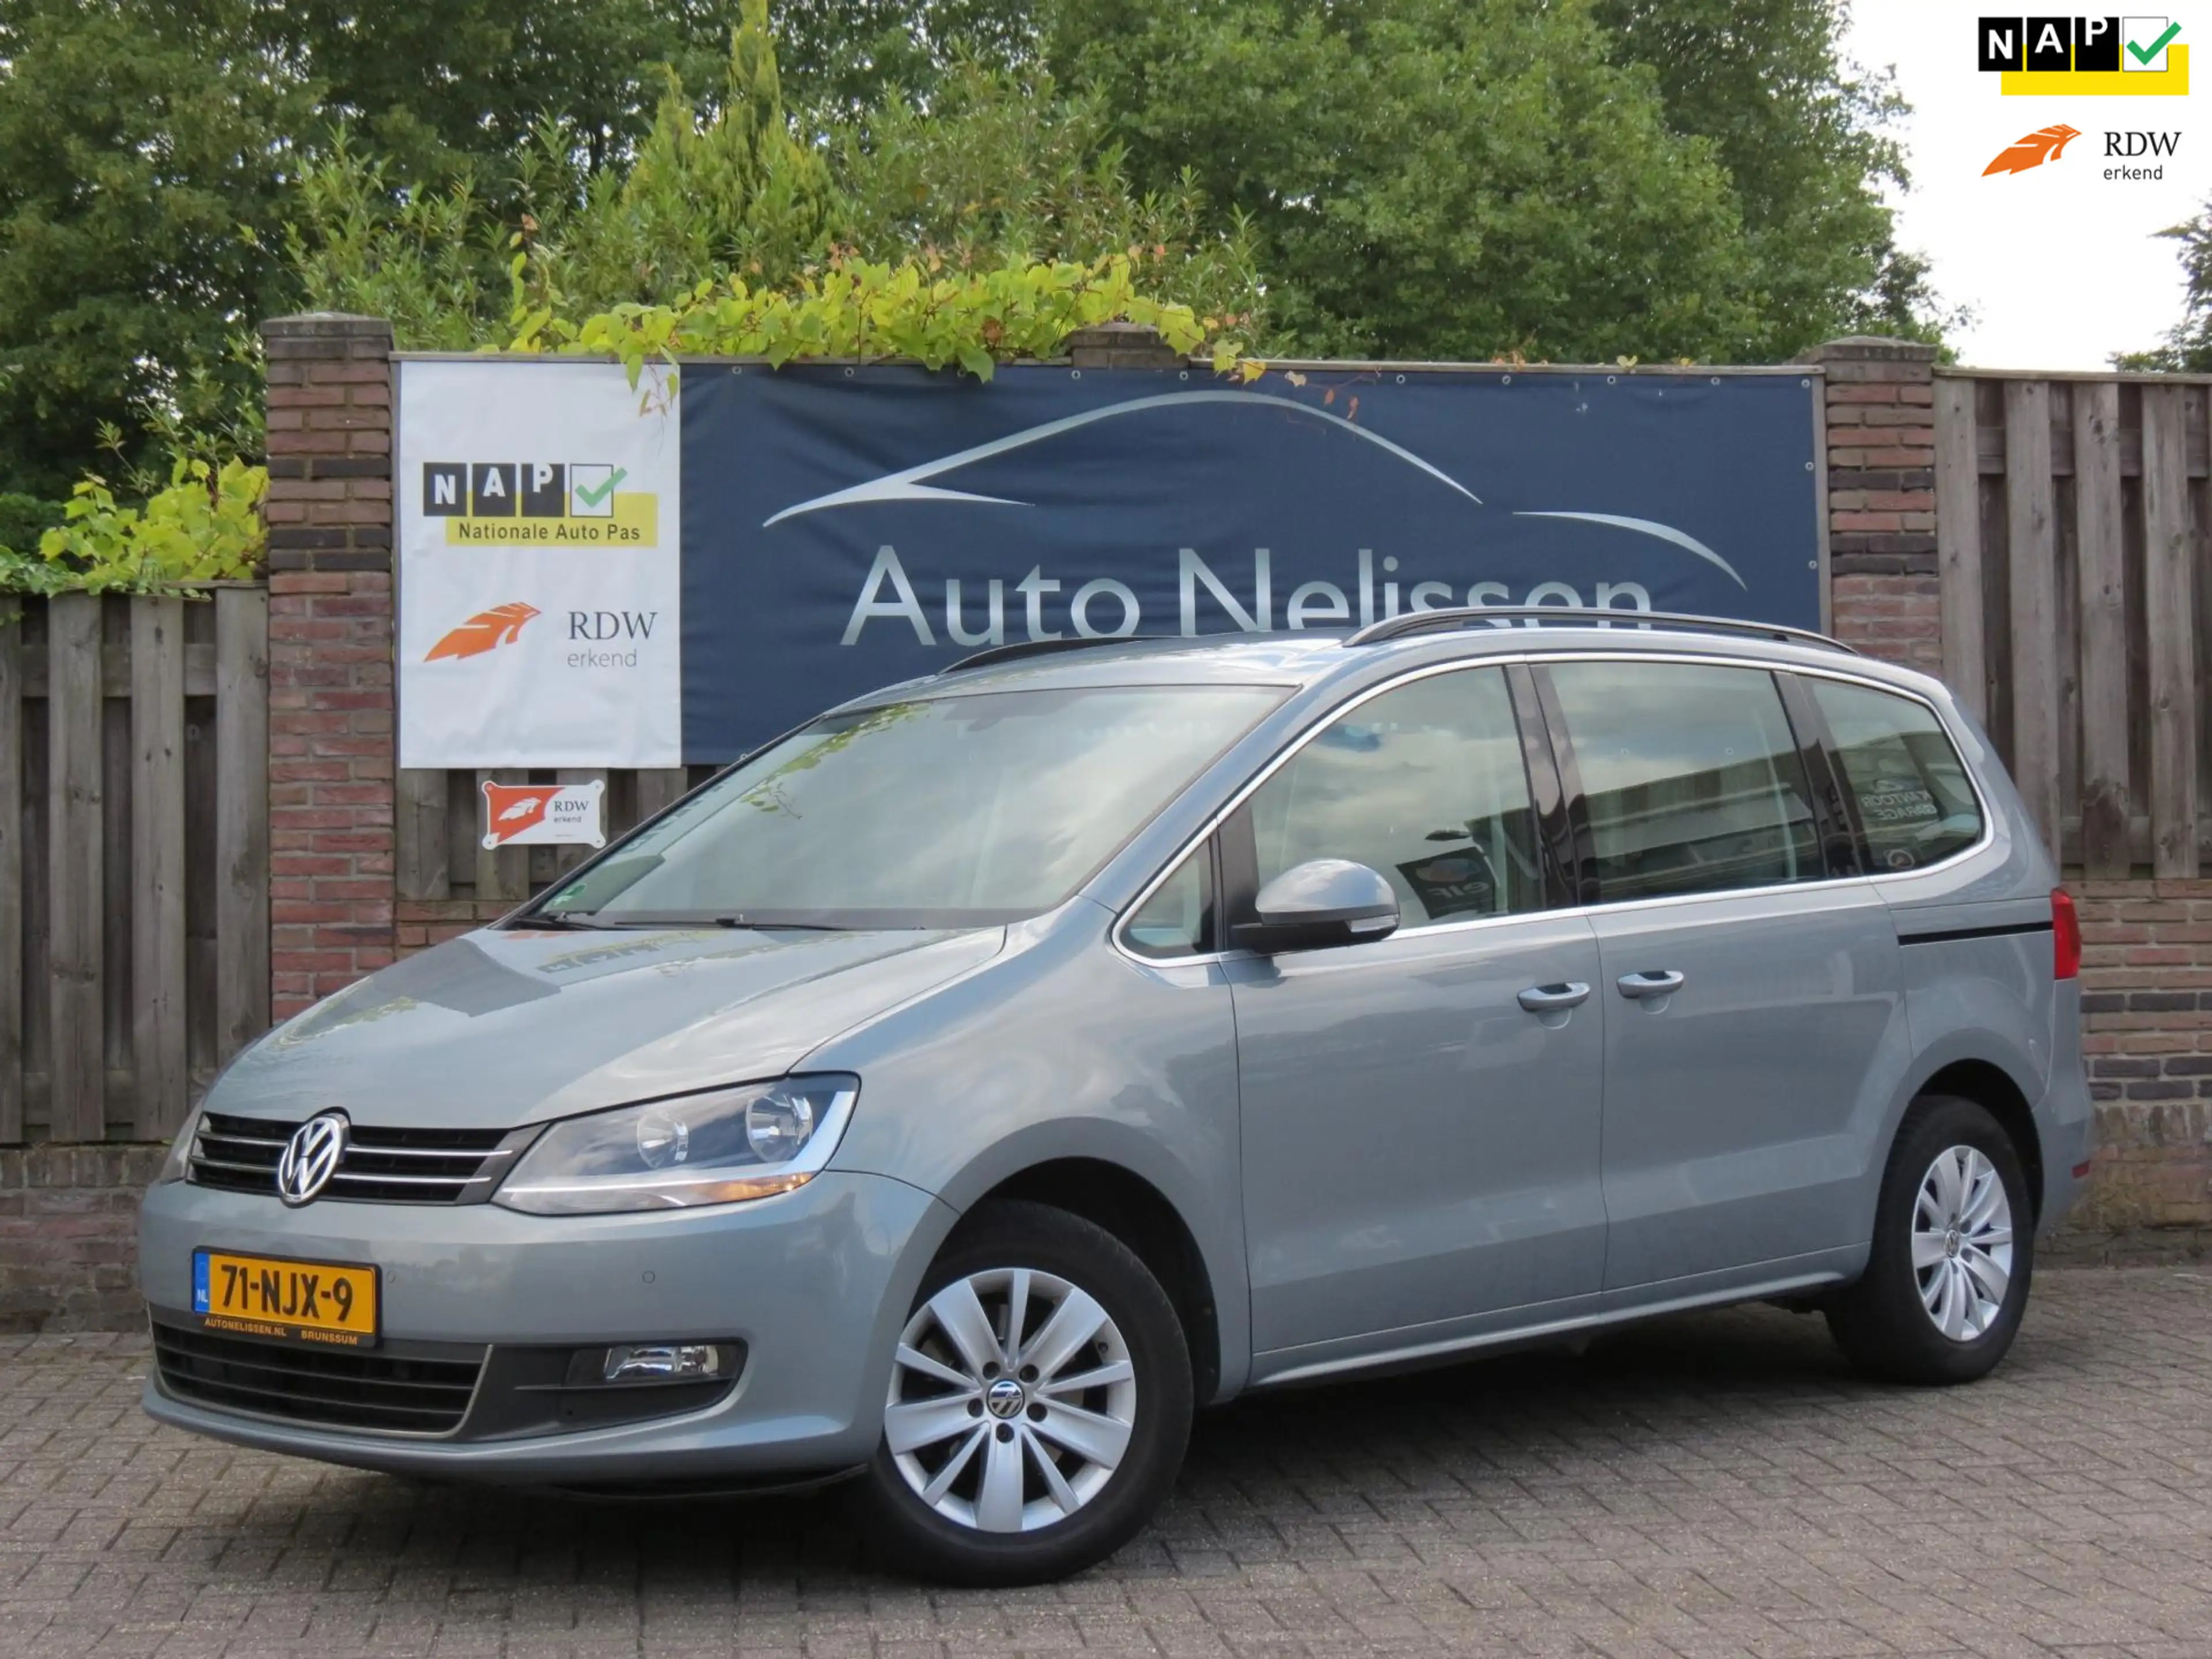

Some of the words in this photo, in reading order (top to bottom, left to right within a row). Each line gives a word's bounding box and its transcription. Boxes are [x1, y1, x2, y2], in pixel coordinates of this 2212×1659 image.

[434, 463, 554, 505] NAP
[459, 522, 548, 540] Nationale
[555, 524, 599, 540] Auto
[607, 524, 640, 540] Pas
[840, 544, 1141, 646] Auto
[568, 611, 658, 641] RDW
[567, 649, 637, 668] erkend
[553, 800, 589, 812] RDW
[196, 1288, 209, 1303] NL
[221, 1264, 353, 1322] 71-NJX-9
[204, 1317, 287, 1337] AUTONELISSEN.NL
[301, 1329, 358, 1346] BRUNSSUM
